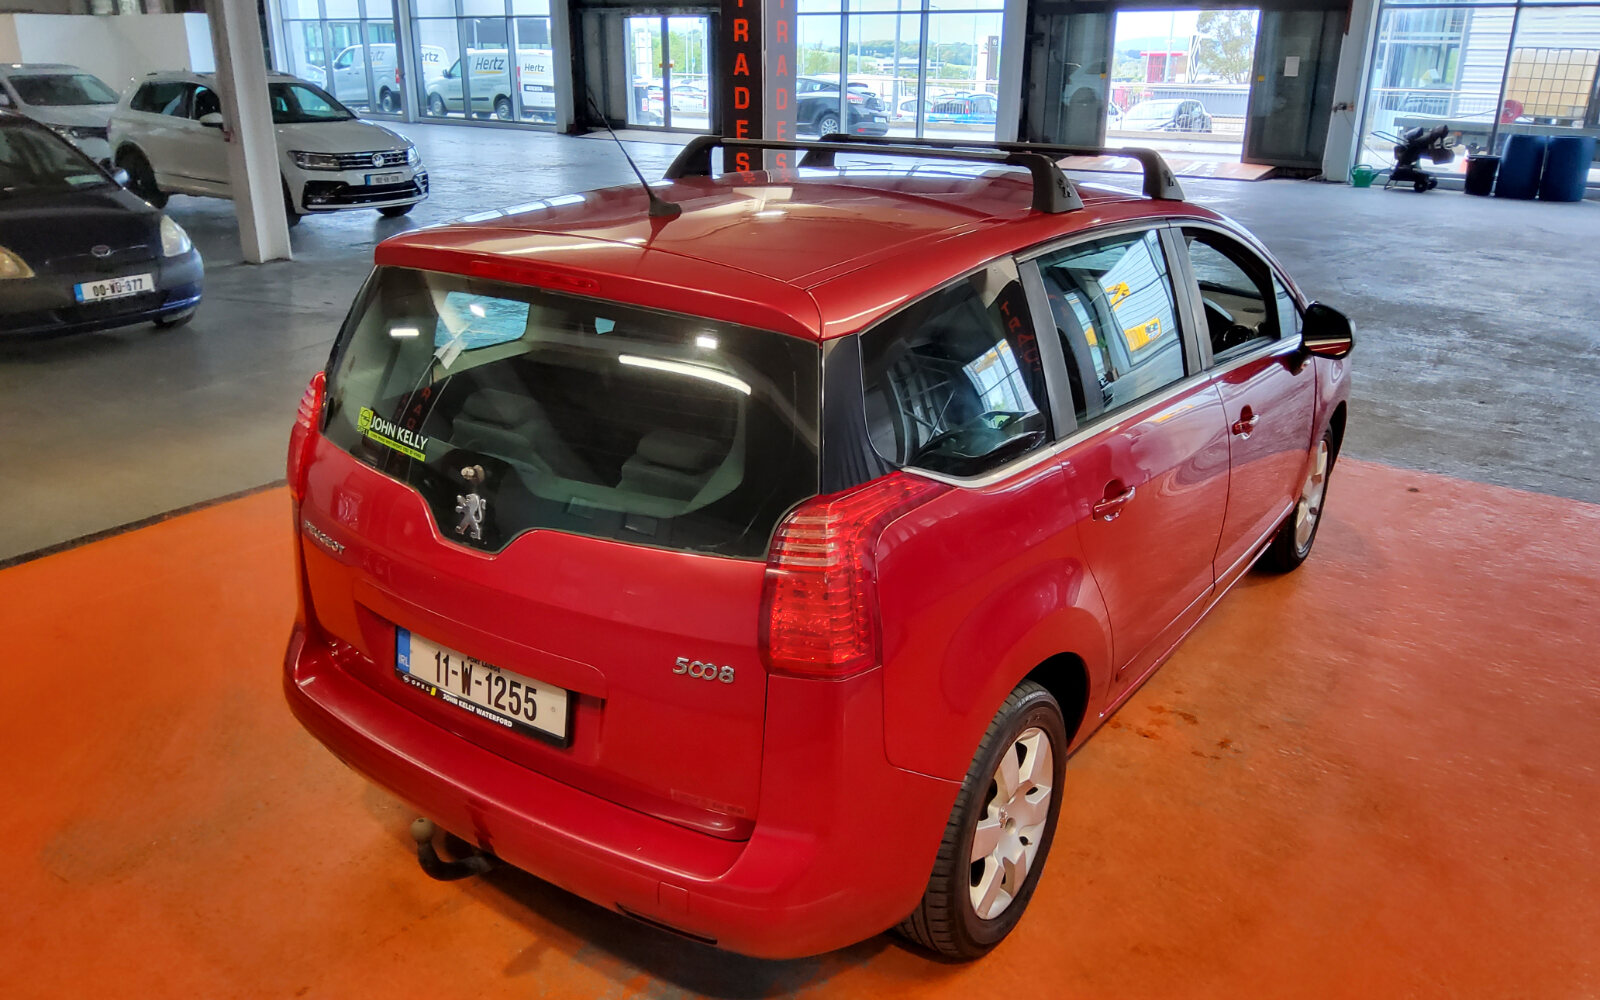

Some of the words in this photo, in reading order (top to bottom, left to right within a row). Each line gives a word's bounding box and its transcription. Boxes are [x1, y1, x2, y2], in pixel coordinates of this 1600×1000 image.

[475, 57, 504, 70] Hertz
[524, 63, 545, 72] Hertz
[370, 415, 397, 438] JOHN
[397, 427, 429, 451] KELLY
[398, 654, 410, 668] IRL
[673, 656, 735, 684] 5008
[411, 680, 430, 692] OPEL
[434, 650, 538, 722] 11-W-1255
[442, 693, 458, 705] JOHN
[458, 698, 476, 712] KELLY
[476, 707, 513, 728] WATERFORD
